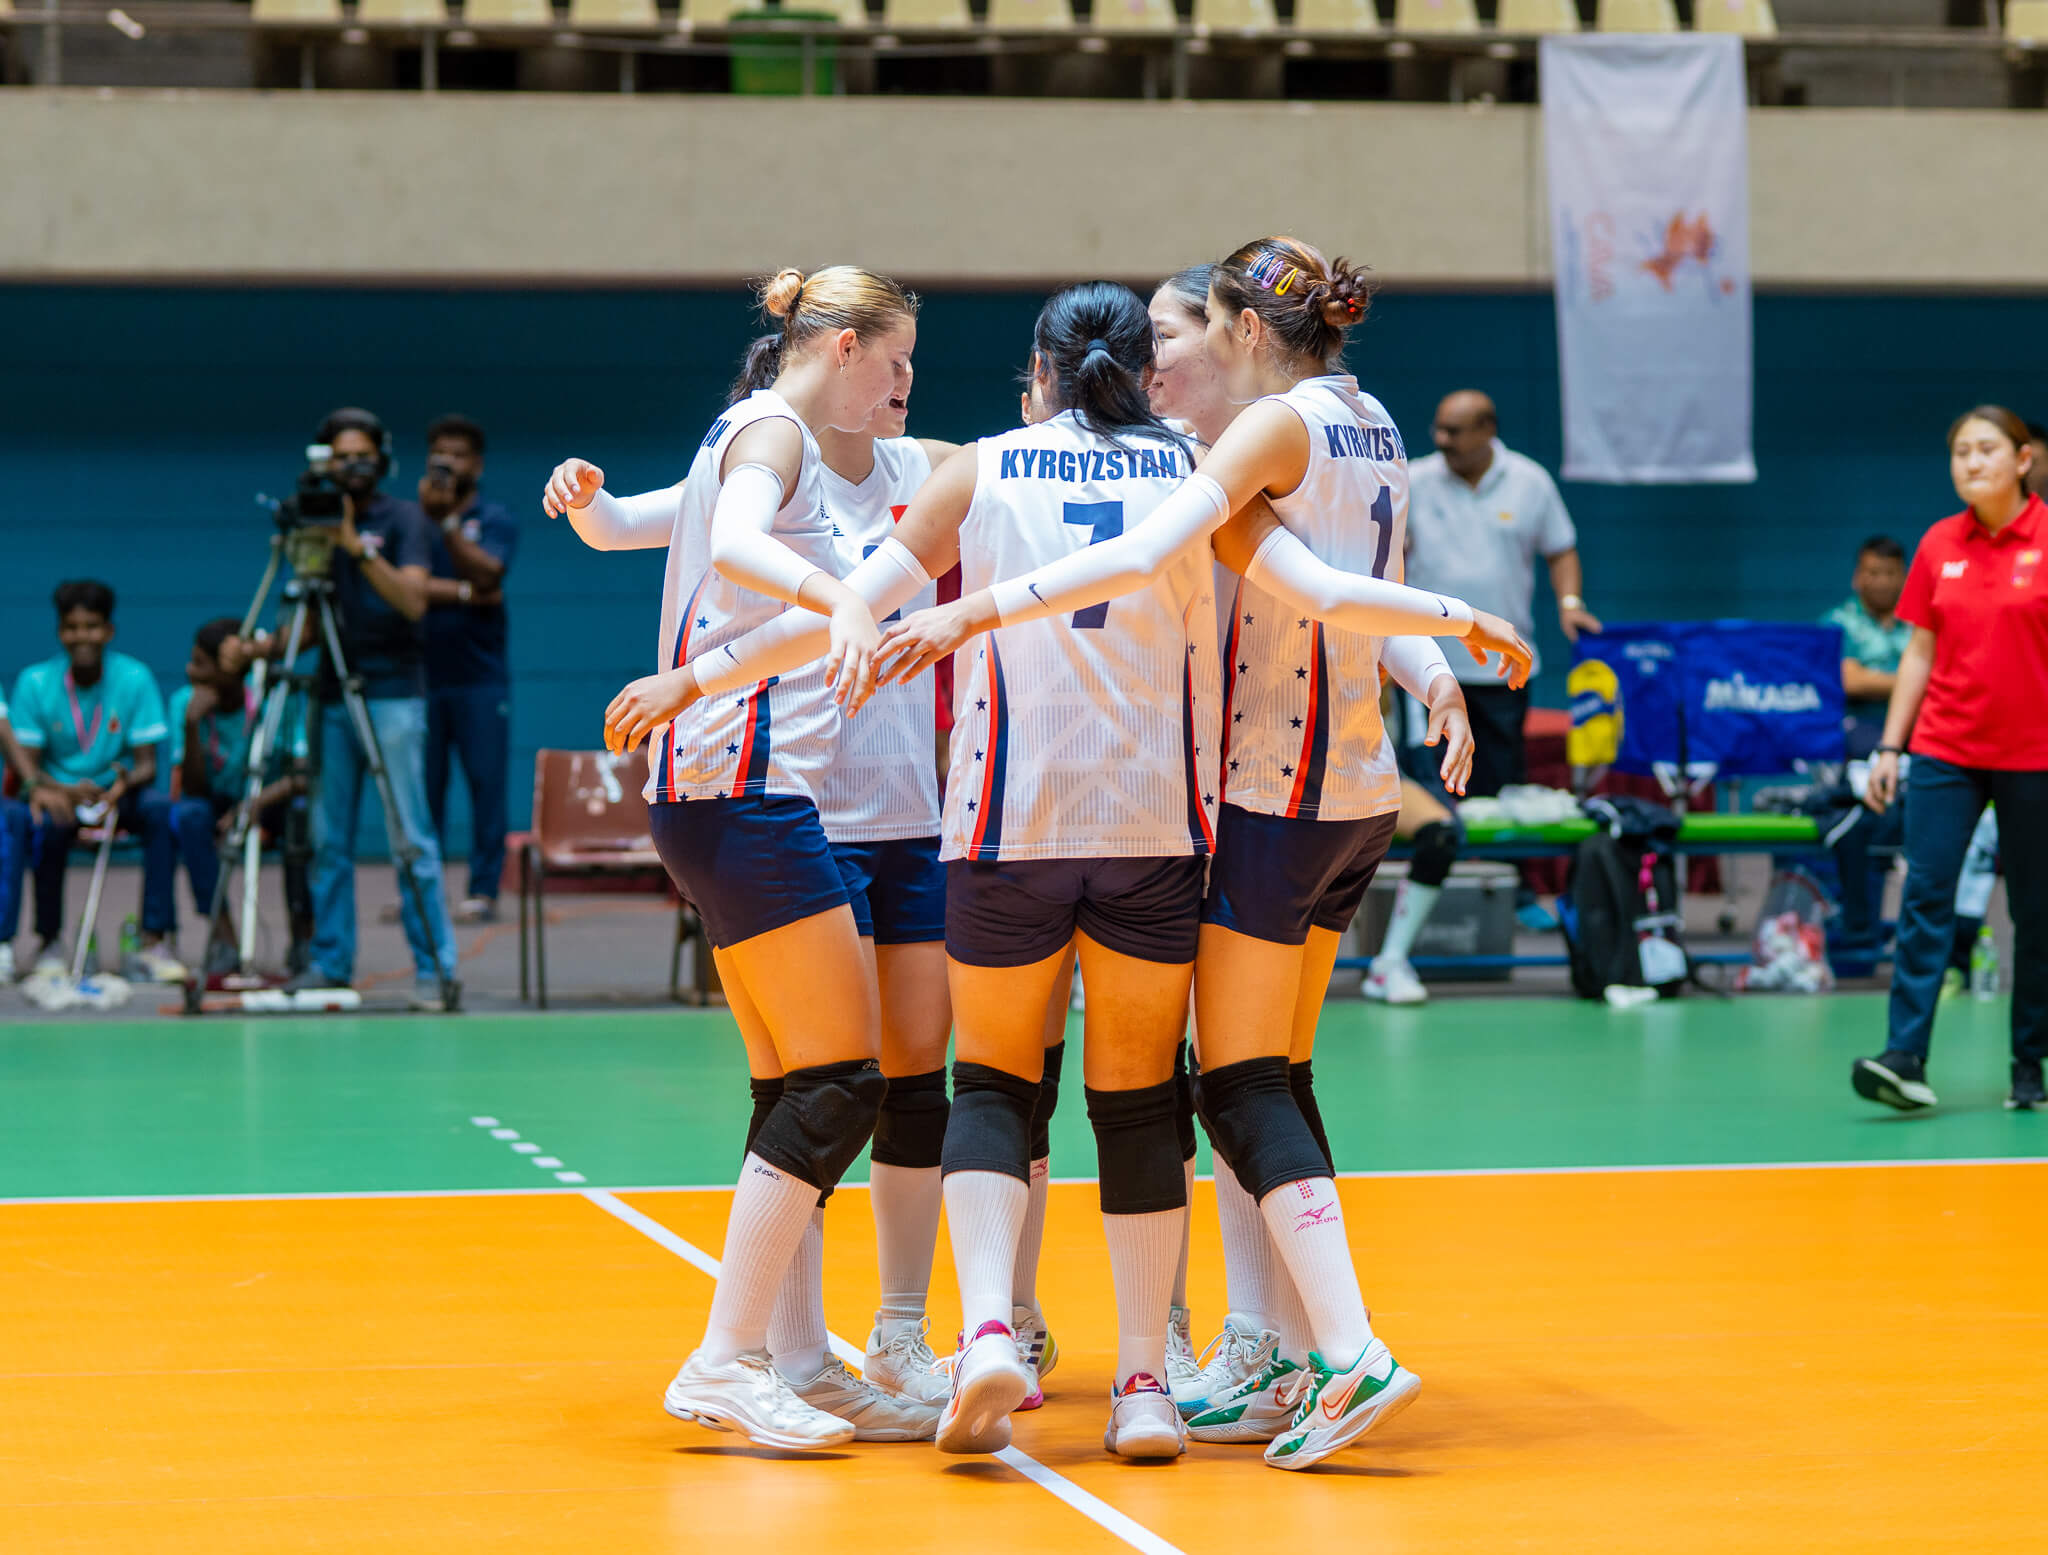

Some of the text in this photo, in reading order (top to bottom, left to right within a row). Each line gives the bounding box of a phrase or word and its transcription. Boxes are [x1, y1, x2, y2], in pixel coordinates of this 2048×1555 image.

[1000, 448, 1178, 483] KYRGYZSTAN
[1063, 500, 1124, 629] 7
[1370, 485, 1393, 579] 1
